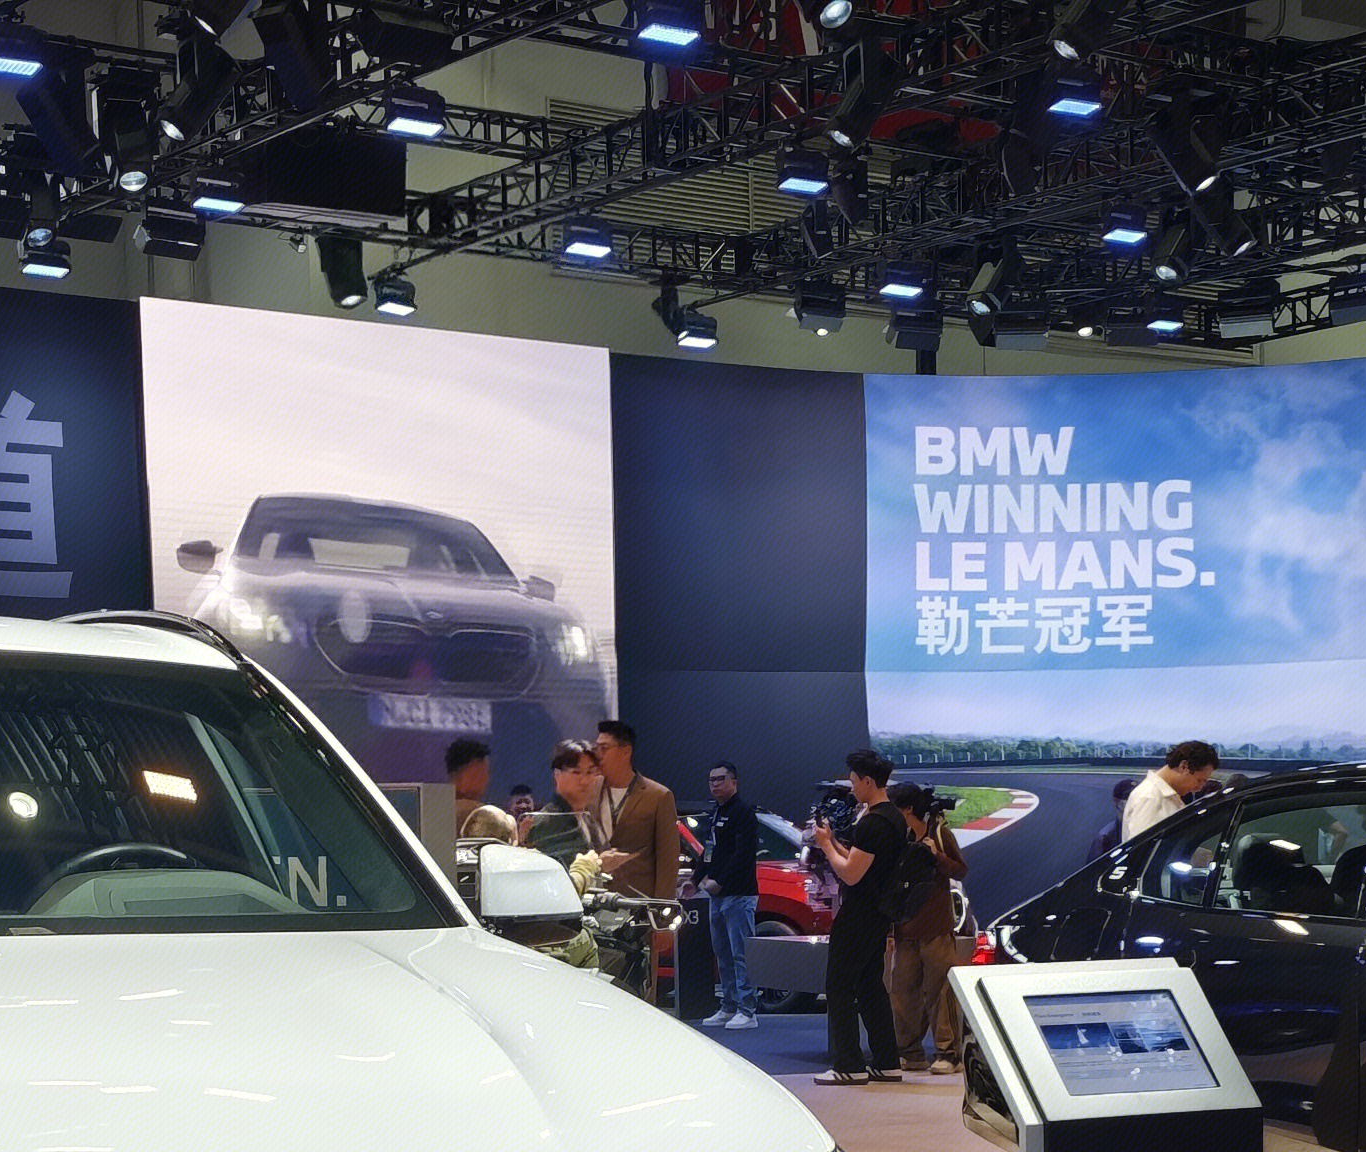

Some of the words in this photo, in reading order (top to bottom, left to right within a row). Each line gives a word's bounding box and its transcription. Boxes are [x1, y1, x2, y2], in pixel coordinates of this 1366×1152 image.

[914, 426, 1075, 476] BMW
[913, 479, 1193, 534] WINNING
[915, 541, 988, 591] LE
[1004, 537, 1215, 591] MANS.
[915, 595, 1154, 656] 勒芒冠军
